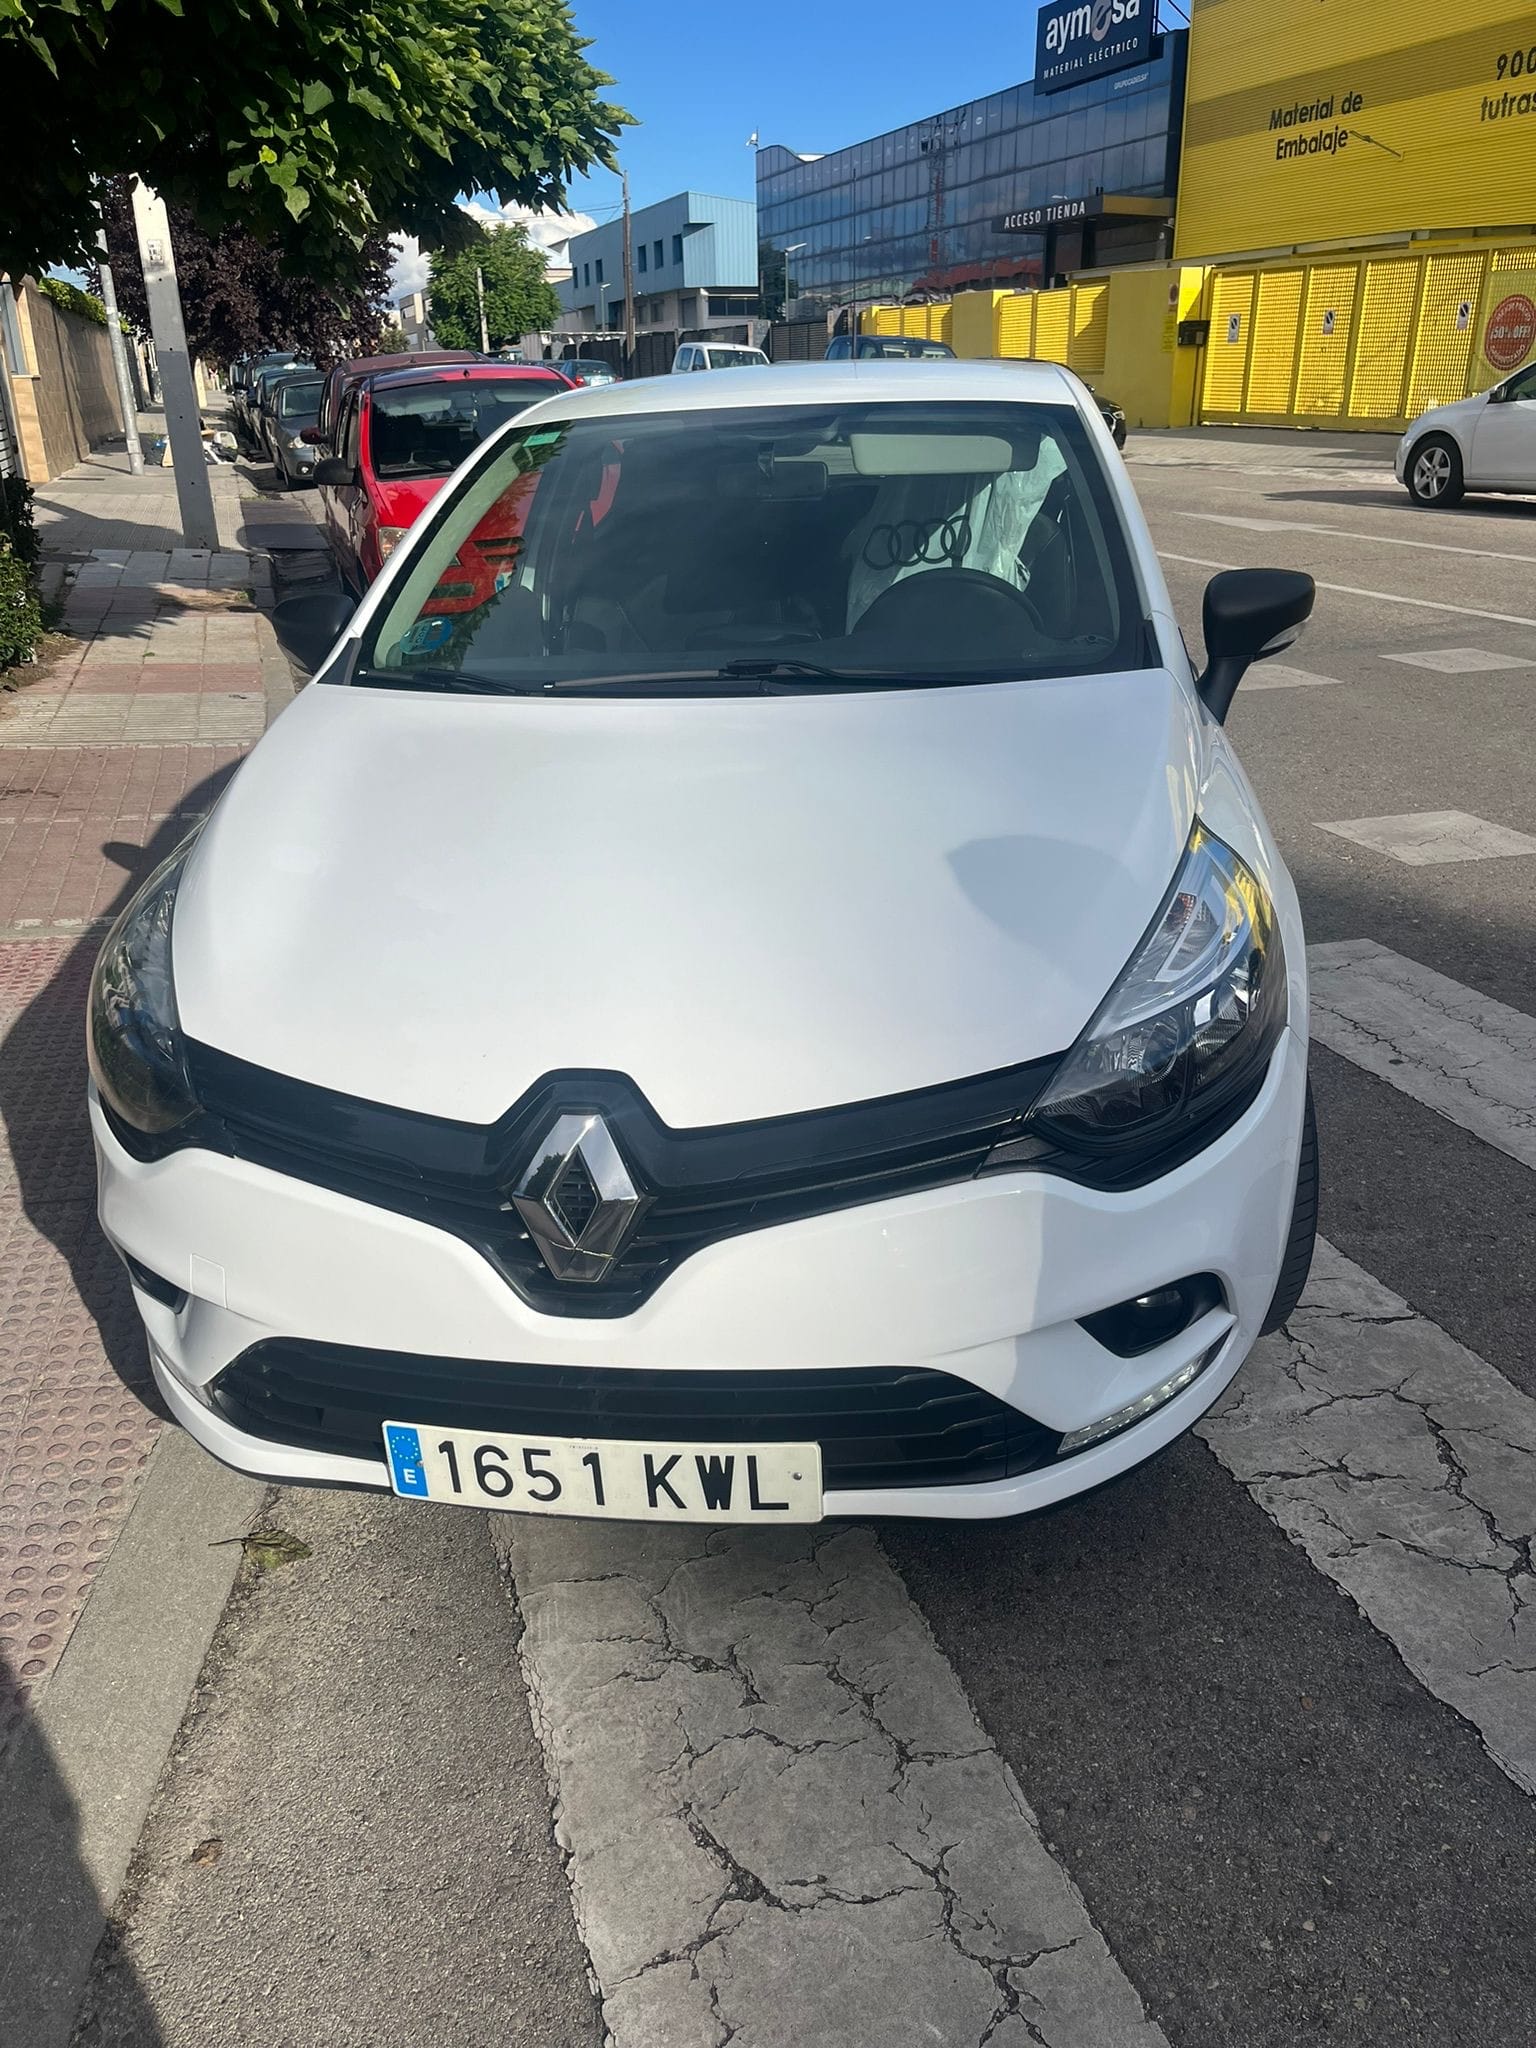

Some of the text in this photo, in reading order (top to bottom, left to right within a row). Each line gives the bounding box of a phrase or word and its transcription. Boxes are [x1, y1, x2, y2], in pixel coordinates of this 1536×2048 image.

[1043, 37, 1138, 80] MATERIAL ELÉCTRICO
[1269, 91, 1363, 131] Material de
[1276, 125, 1348, 160] Embalaje
[1004, 201, 1085, 229] ACCESO TIENDA
[438, 1440, 789, 1511] 1651 KWL
